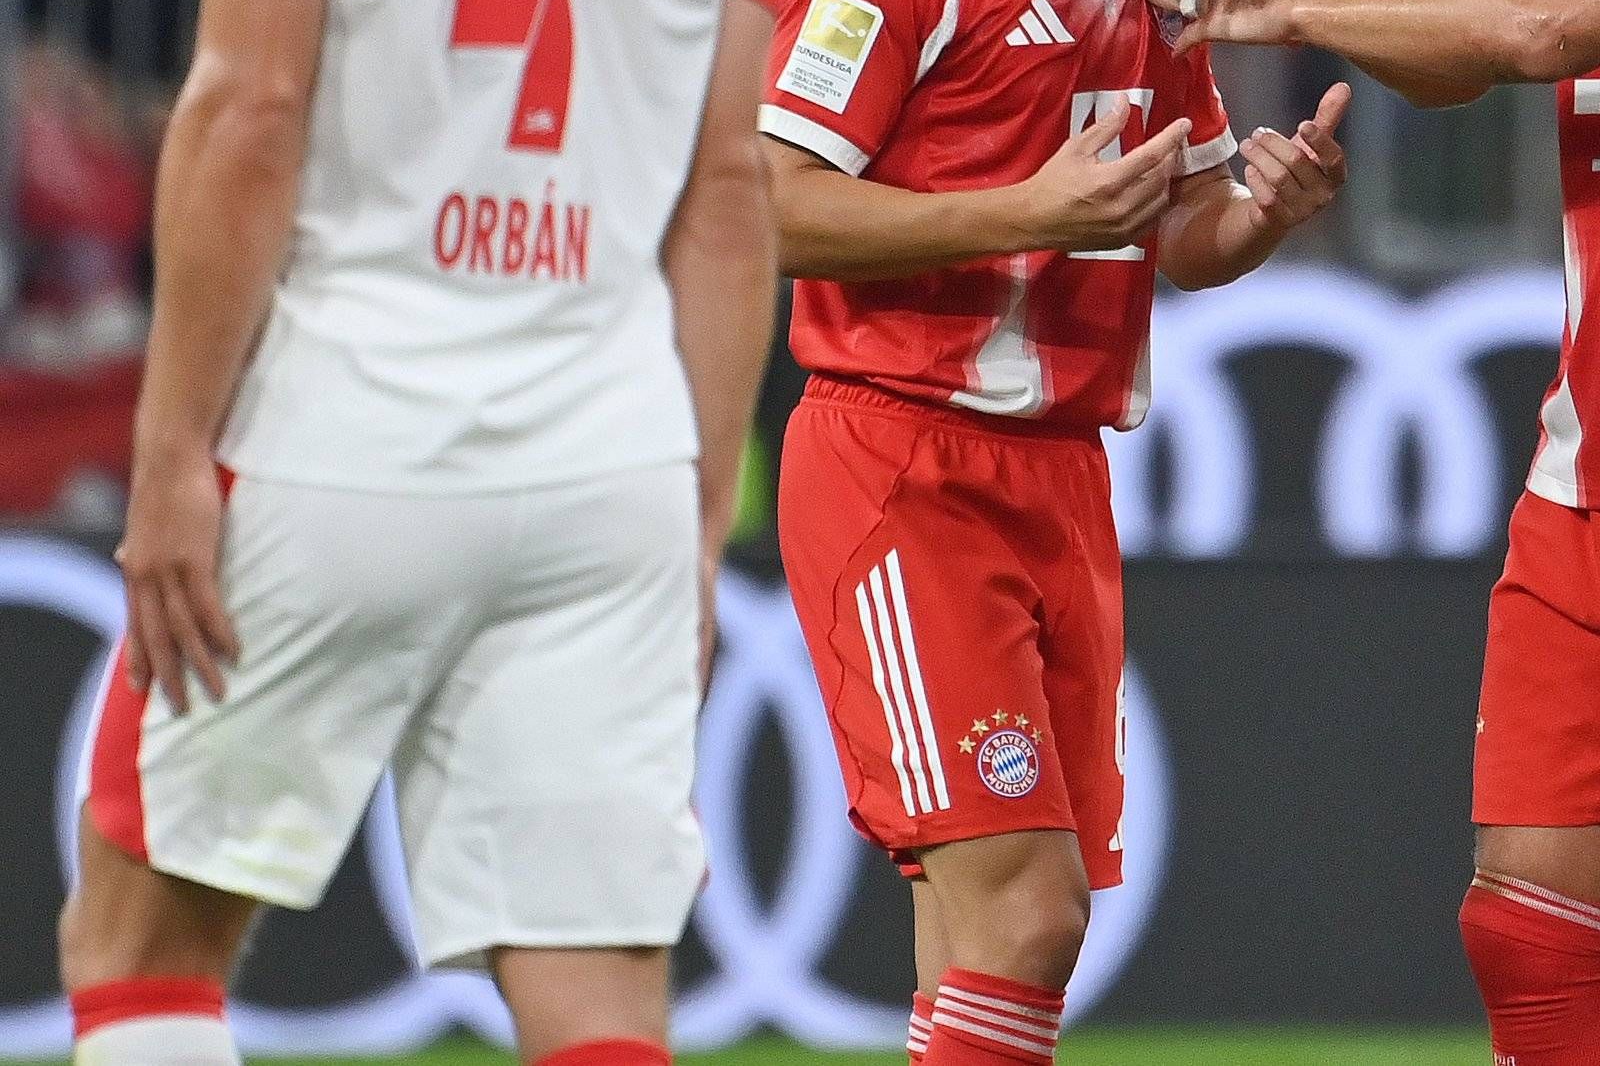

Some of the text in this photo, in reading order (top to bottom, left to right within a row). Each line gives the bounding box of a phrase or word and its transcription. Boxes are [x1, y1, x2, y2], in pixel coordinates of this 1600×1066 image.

[433, 176, 593, 285] ORBÁN
[982, 735, 1034, 763] FC BAYERN
